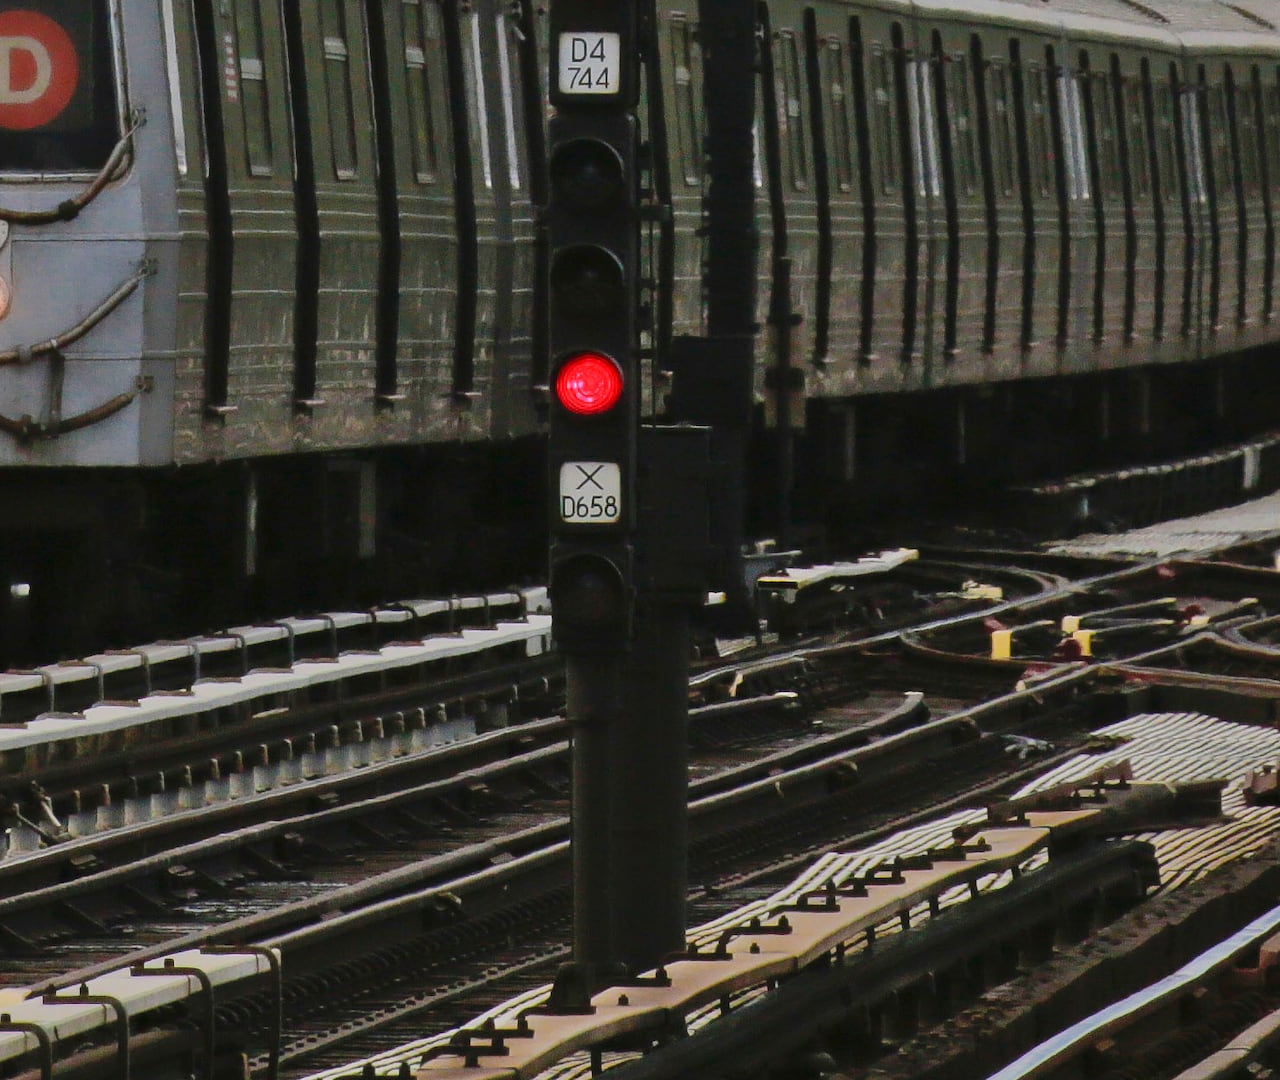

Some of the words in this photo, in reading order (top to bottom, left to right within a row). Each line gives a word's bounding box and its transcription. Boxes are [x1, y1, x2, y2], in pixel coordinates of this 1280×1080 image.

[571, 37, 606, 63] D4
[567, 66, 610, 89] 744
[575, 464, 605, 490] X
[562, 495, 618, 519] D658
